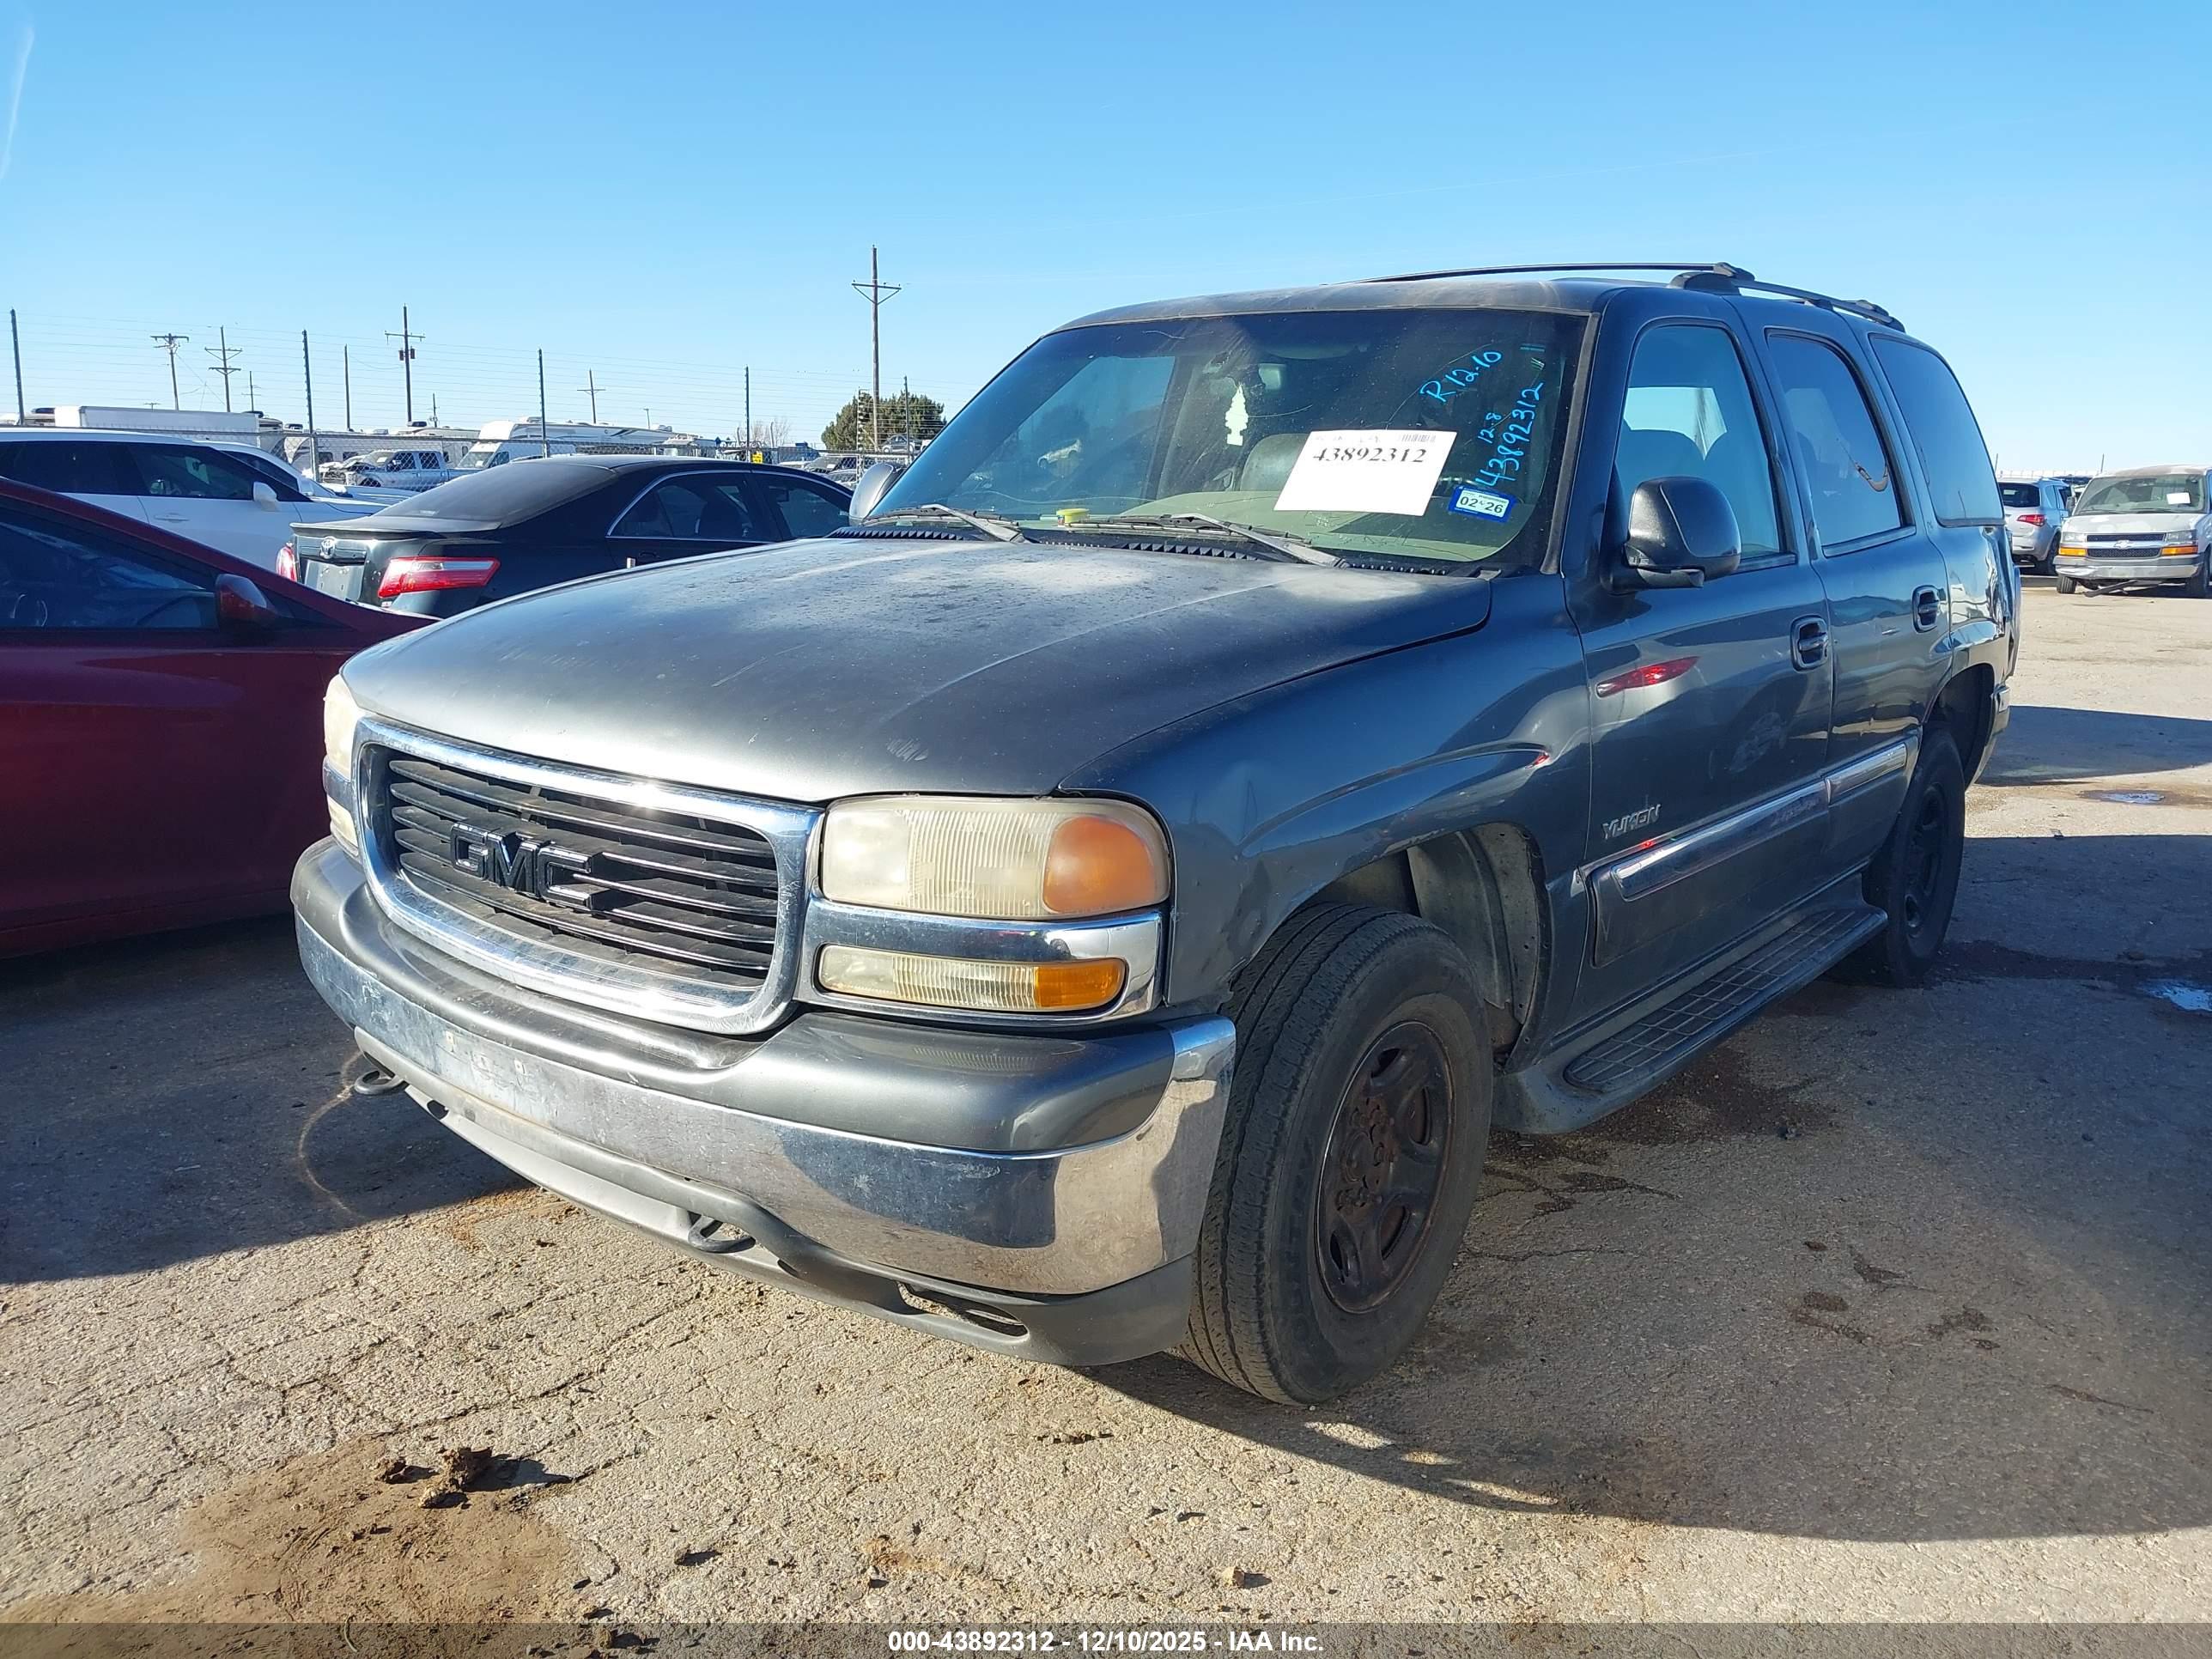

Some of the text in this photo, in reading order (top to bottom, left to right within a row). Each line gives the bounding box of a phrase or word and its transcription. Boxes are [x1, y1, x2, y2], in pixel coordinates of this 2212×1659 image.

[1312, 447, 1427, 464] 43892312
[1474, 382, 1544, 487] 43892312
[1460, 496, 1479, 508] 02
[1485, 501, 1504, 514] 26
[450, 822, 594, 911] GMC
